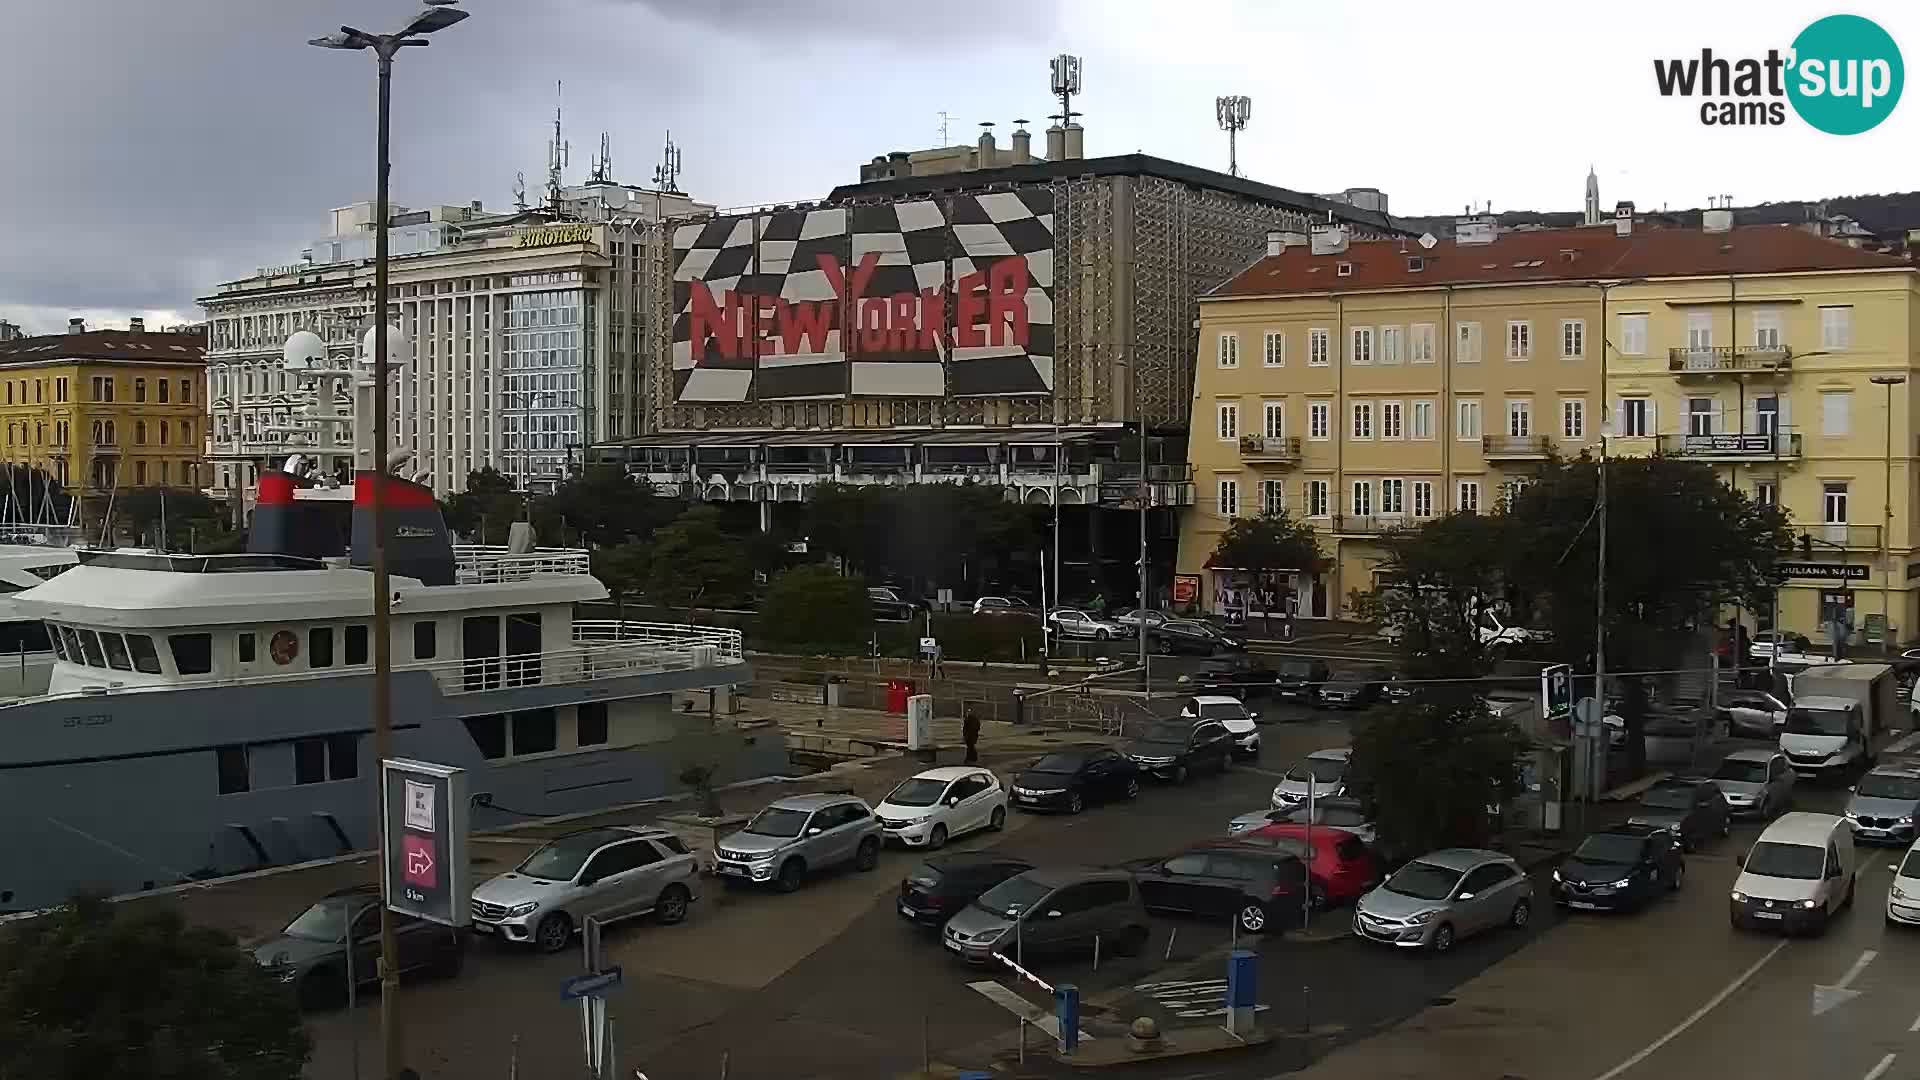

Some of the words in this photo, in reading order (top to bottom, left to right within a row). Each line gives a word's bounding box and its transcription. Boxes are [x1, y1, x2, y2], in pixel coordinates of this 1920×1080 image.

[815, 251, 1030, 353] YORKER
[1781, 567, 1828, 575] JULIANA
[1831, 568, 1864, 576] NAILS
